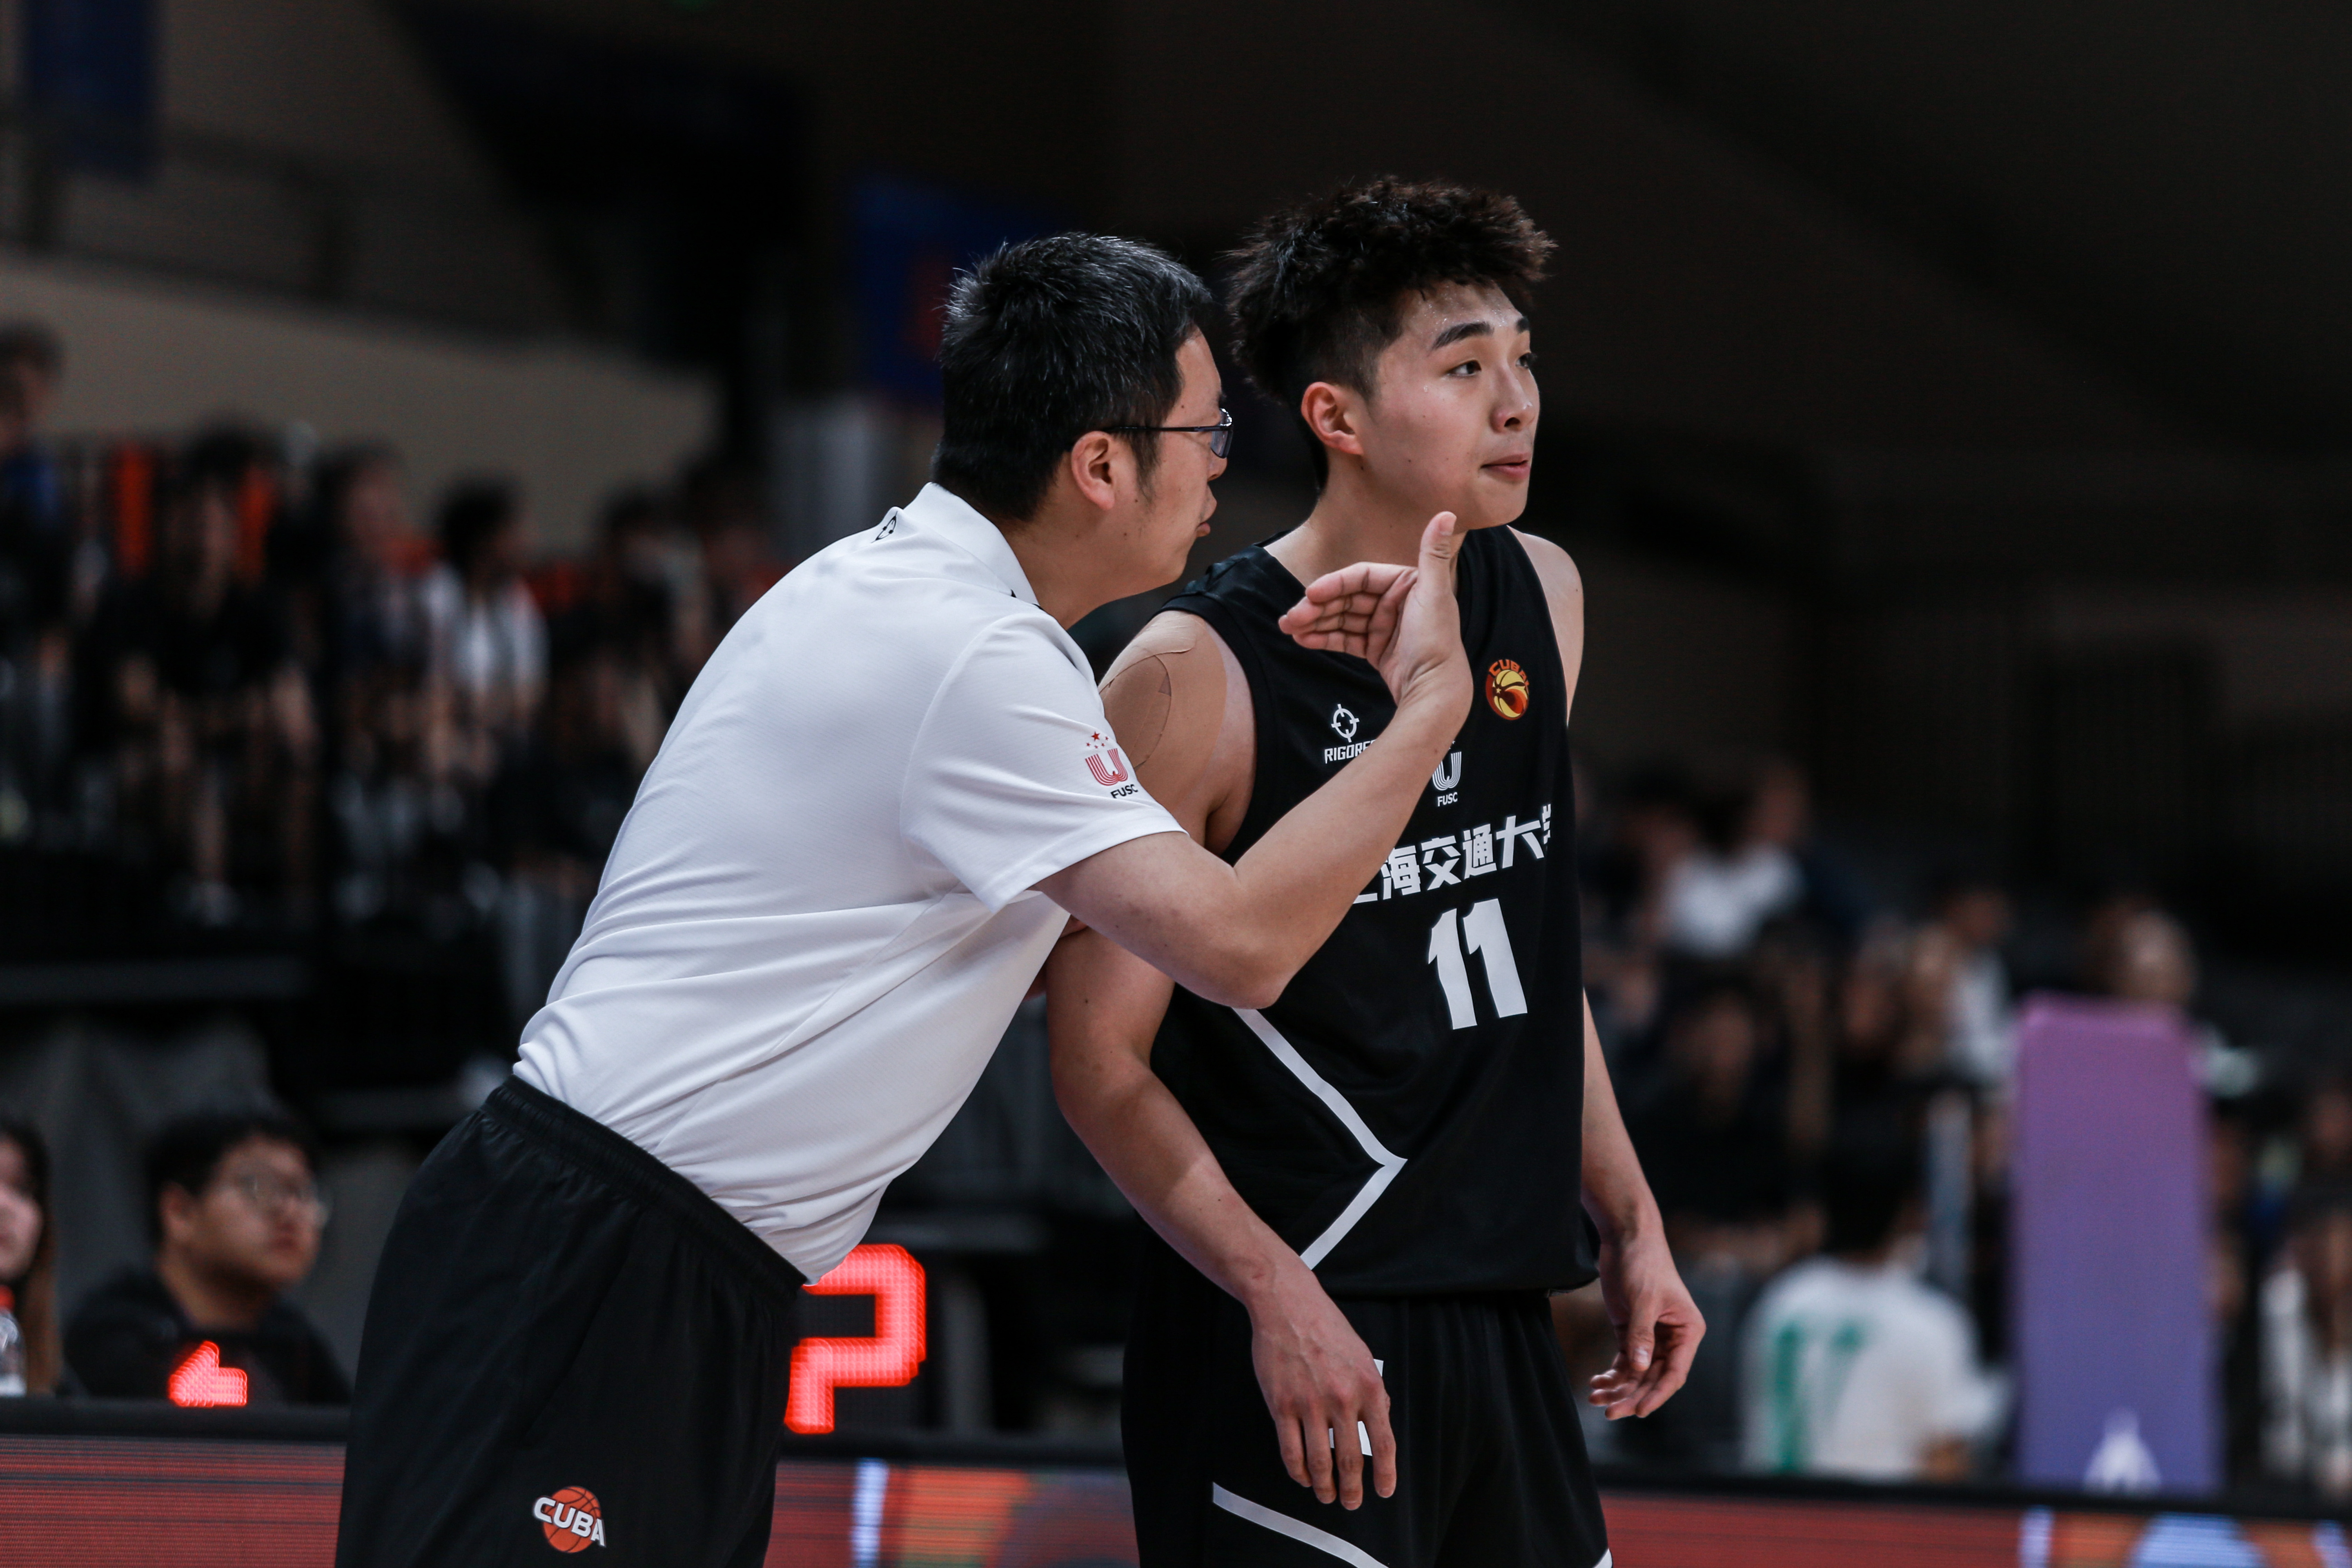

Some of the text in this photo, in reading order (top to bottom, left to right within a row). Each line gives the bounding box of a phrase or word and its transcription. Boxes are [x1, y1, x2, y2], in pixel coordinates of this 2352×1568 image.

[1324, 739, 1377, 764] RIGORE
[1110, 784, 1138, 799] FUSC
[1437, 792, 1458, 807] FUSC
[1352, 804, 1552, 904] 海交通大
[1428, 898, 1528, 1030] 11
[533, 1496, 606, 1547] CUBA
